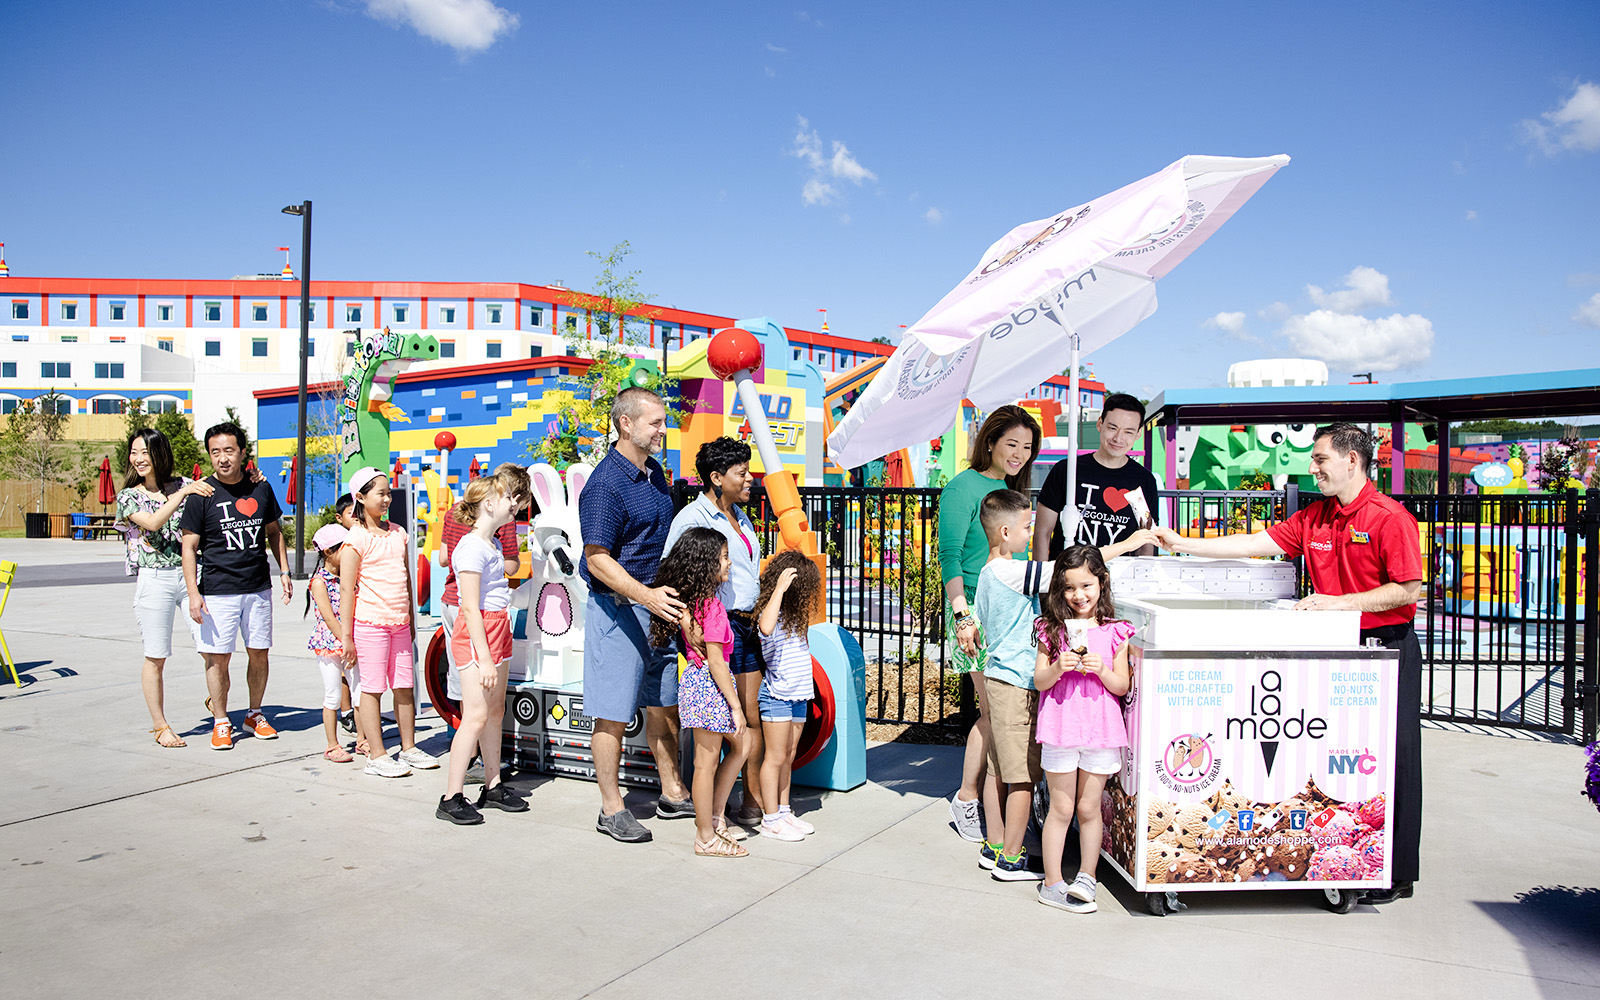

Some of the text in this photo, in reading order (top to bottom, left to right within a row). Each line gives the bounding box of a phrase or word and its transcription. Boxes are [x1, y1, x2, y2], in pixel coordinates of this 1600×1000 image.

[1077, 482, 1100, 510] I
[216, 500, 236, 523] I
[1078, 509, 1129, 524] EGOLAND
[220, 518, 262, 530] LEGOLAND
[221, 525, 261, 550] NY
[1077, 519, 1127, 548] NY
[1169, 671, 1222, 681] ICE CREAM
[1260, 670, 1282, 692] a
[1331, 672, 1380, 683] DELICIOUS,
[1157, 684, 1234, 694] HAND-CRAFTED
[1334, 685, 1374, 694] NO-NUTS
[1167, 696, 1222, 706] WITH CARE
[1251, 685, 1282, 716] la
[1330, 697, 1378, 706] ICE CREAM
[1226, 708, 1328, 740] mode
[1328, 753, 1377, 775] NYC
[1155, 758, 1222, 794] THE 100% NO-NUTS ICE CREAM
[1194, 835, 1342, 847] www.alamodeshoppe.com
